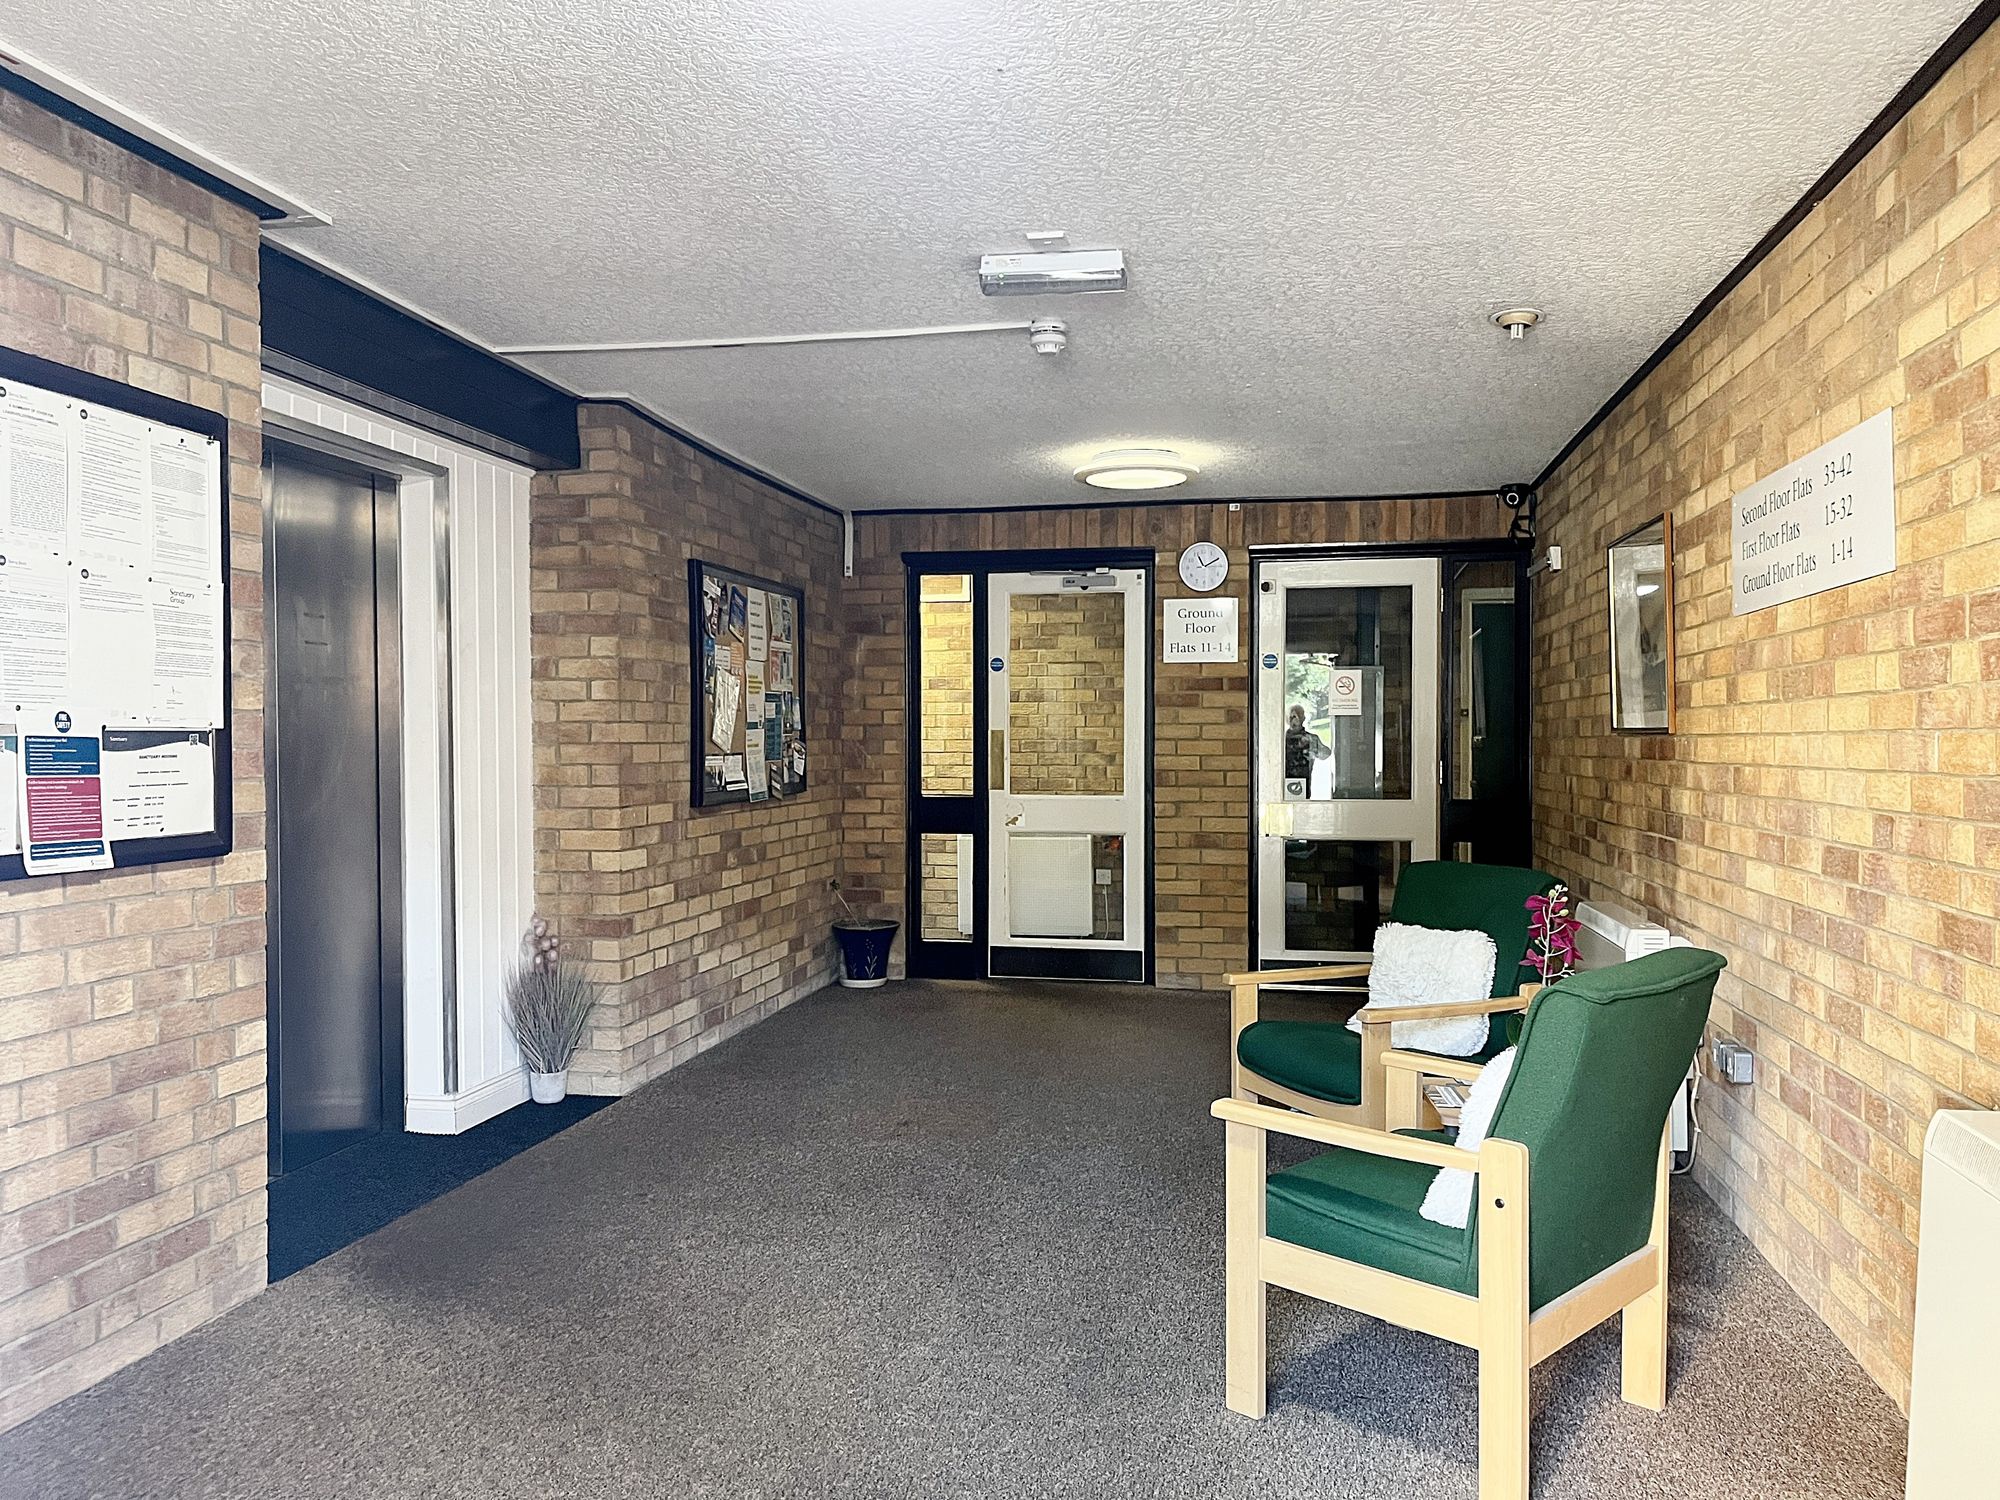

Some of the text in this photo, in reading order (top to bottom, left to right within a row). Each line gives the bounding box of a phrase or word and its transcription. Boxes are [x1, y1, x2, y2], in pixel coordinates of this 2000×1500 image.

[1741, 452, 1852, 527] Second Floor Flats 33-42
[1742, 494, 1853, 561] First Floor Flats 15-32
[1742, 536, 1853, 594] Ground Floor Flats 1-14
[170, 588, 195, 599] Sanctuary
[170, 596, 185, 605] Group
[1185, 622, 1216, 633] Floor
[1170, 642, 1231, 653] Flats 11-14
